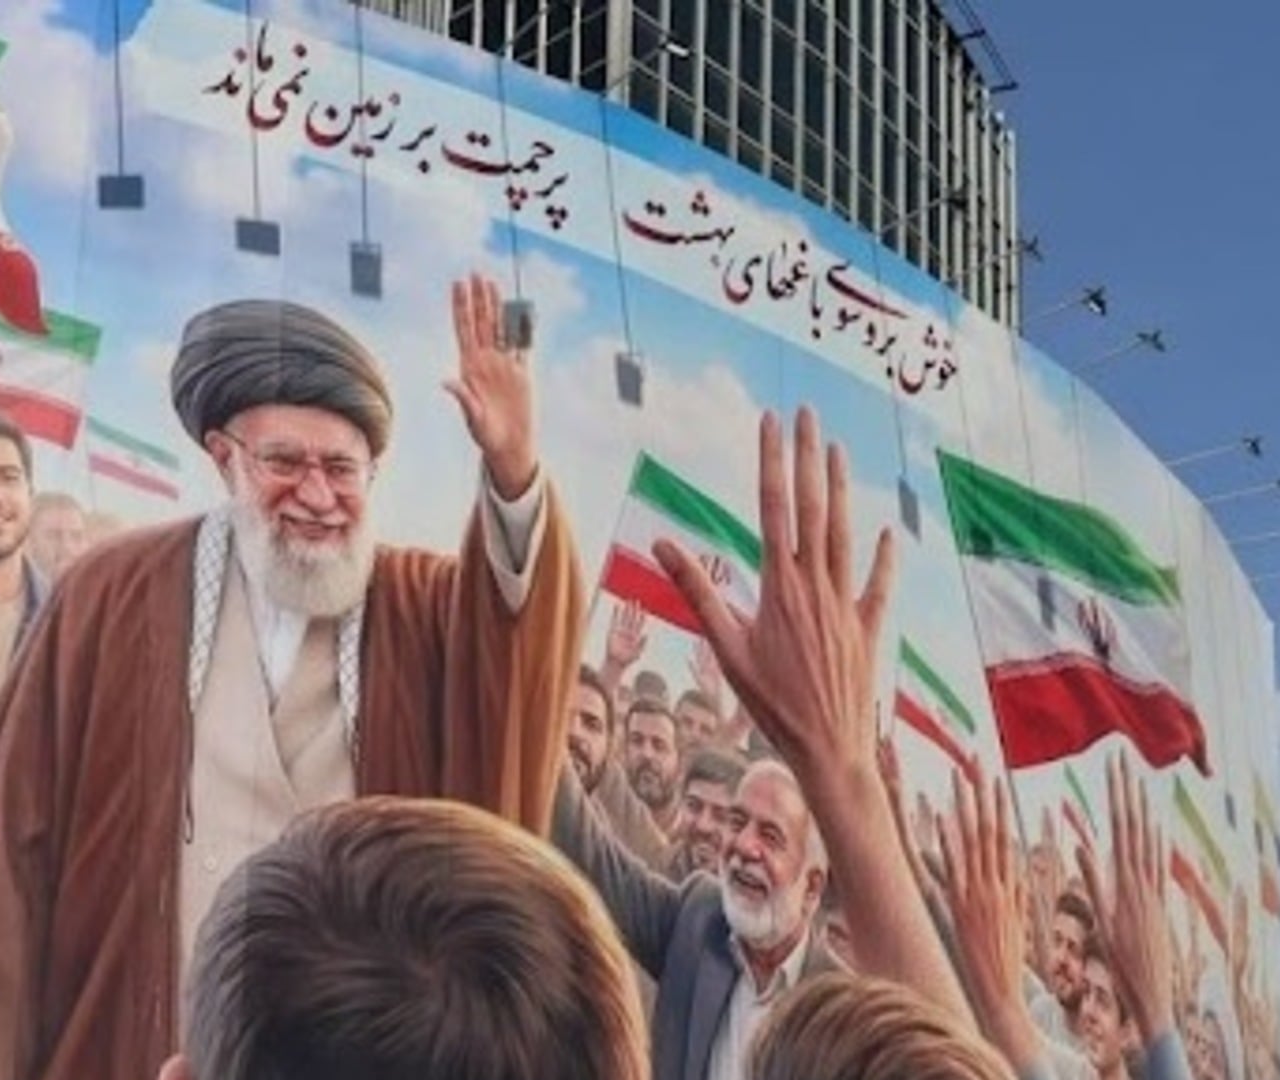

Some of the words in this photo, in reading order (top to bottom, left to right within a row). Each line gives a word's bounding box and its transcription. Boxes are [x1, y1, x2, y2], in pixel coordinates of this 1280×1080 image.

[305, 92, 401, 158] زمین
[622, 190, 735, 266] بهشت
[899, 323, 957, 395] خوش
